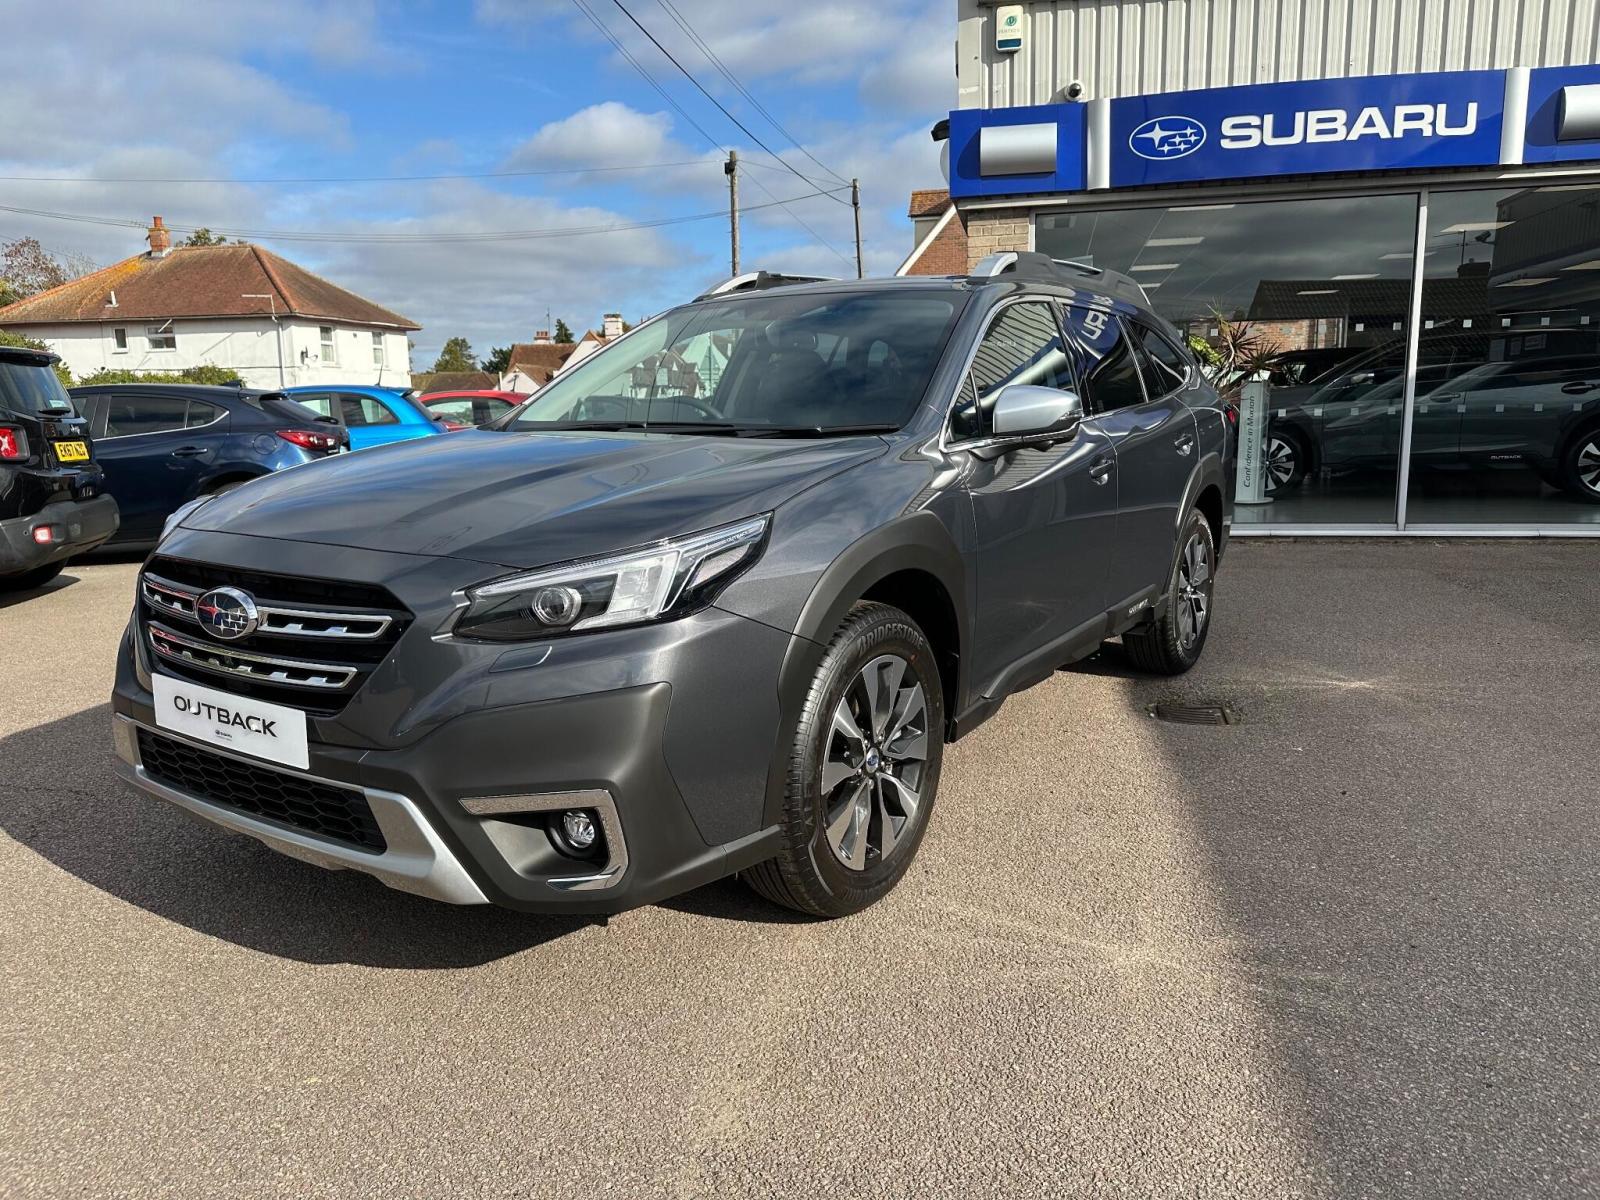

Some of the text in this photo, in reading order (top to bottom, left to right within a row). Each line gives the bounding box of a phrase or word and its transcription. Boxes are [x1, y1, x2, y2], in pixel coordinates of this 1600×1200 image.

[1220, 102, 1478, 149] SUBARU
[1243, 437, 1253, 488] Confidence
[857, 623, 924, 657] BRIDGESTONE
[173, 695, 278, 738] OUTBACK
